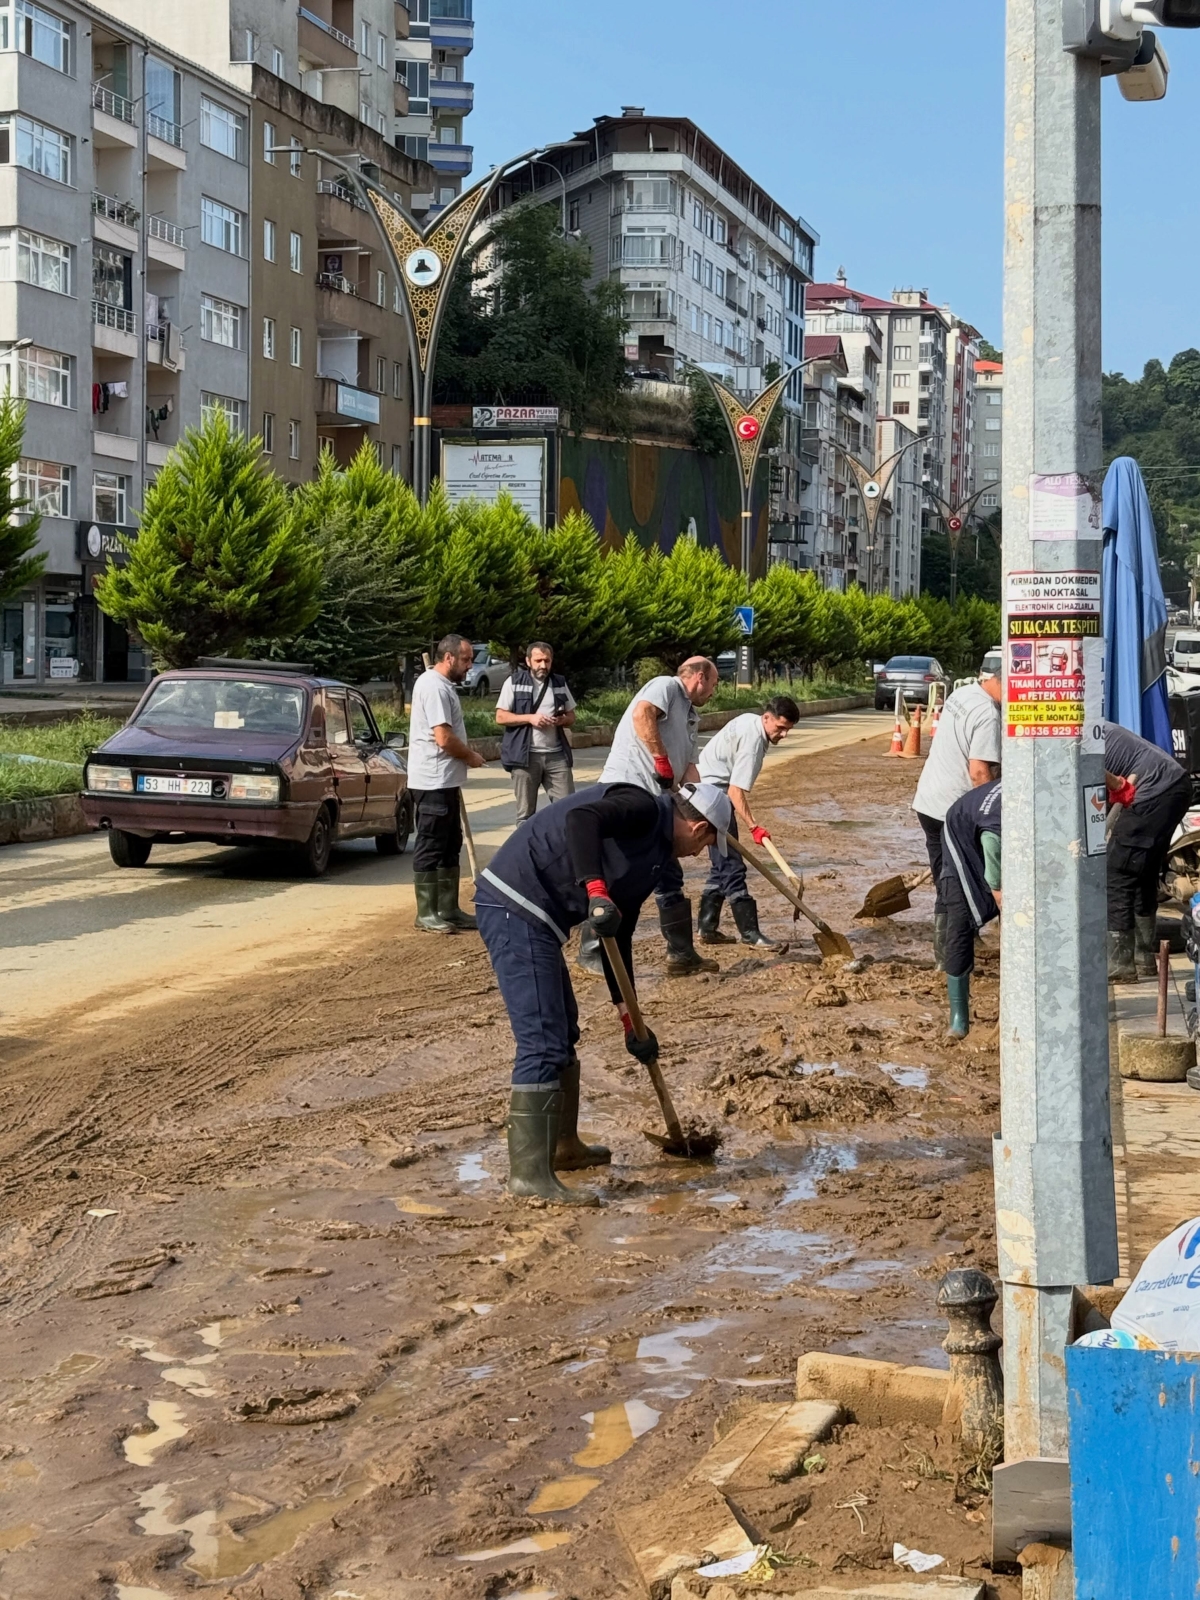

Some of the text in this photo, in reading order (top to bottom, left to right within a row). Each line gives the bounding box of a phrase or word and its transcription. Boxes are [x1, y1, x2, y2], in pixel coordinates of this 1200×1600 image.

[496, 408, 536, 418] PAZAR
[1044, 476, 1061, 485] ALO
[1010, 574, 1098, 586] KIRMADAN DÖKMEDEN
[1021, 588, 1089, 598] %100 NOKTASAL
[1015, 601, 1095, 611] ELEKTRONİK CİHAZLARLA
[1010, 616, 1098, 637] SU KAÇAK TESPİTİ
[1010, 679, 1042, 689] TIKANIK
[1044, 676, 1075, 689] GİDER
[1018, 693, 1027, 701] ve
[1027, 691, 1057, 701] PETEK
[1045, 704, 1057, 712] SU
[1033, 714, 1044, 722] VE
[1046, 714, 1079, 722] MONTAJ
[1024, 726, 1050, 736] 0536
[1052, 726, 1072, 736] 929
[145, 778, 211, 794] 53 HH 223
[1091, 814, 1106, 824] 053
